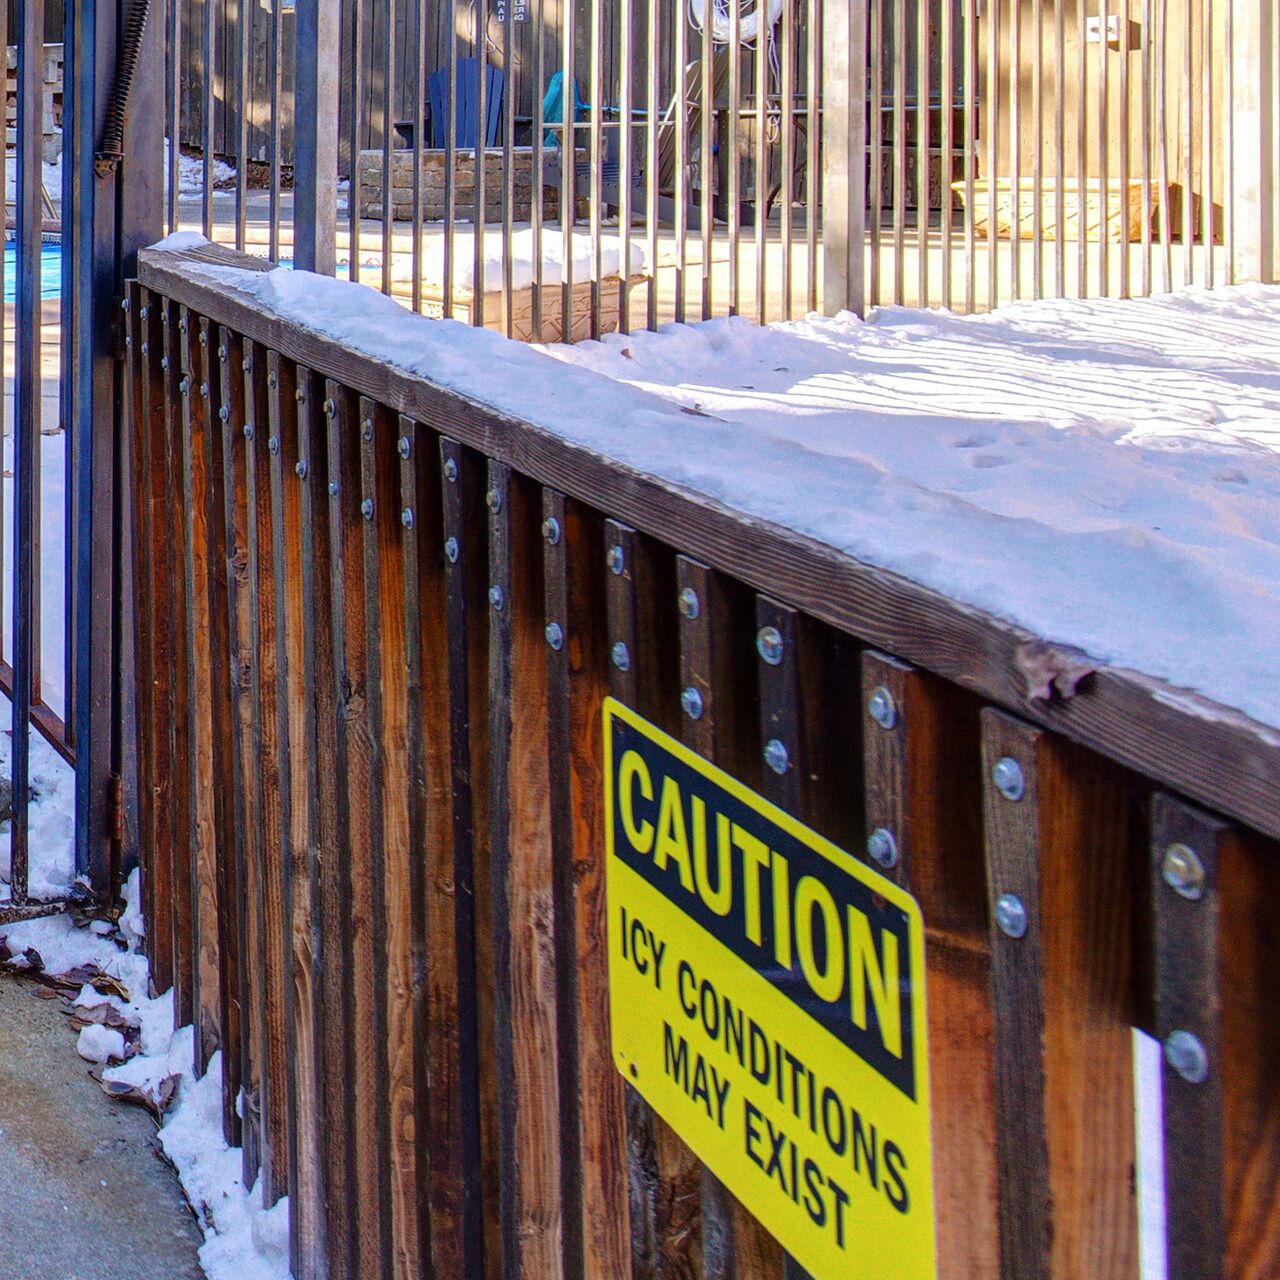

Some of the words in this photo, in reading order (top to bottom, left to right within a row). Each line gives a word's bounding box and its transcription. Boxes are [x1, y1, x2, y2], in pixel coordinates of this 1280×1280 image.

[617, 749, 903, 1061] CAUTION
[620, 905, 666, 991] ICY
[678, 959, 910, 1214] CONDITIONS
[664, 1019, 731, 1132] MAY
[744, 1102, 850, 1251] EXIST
